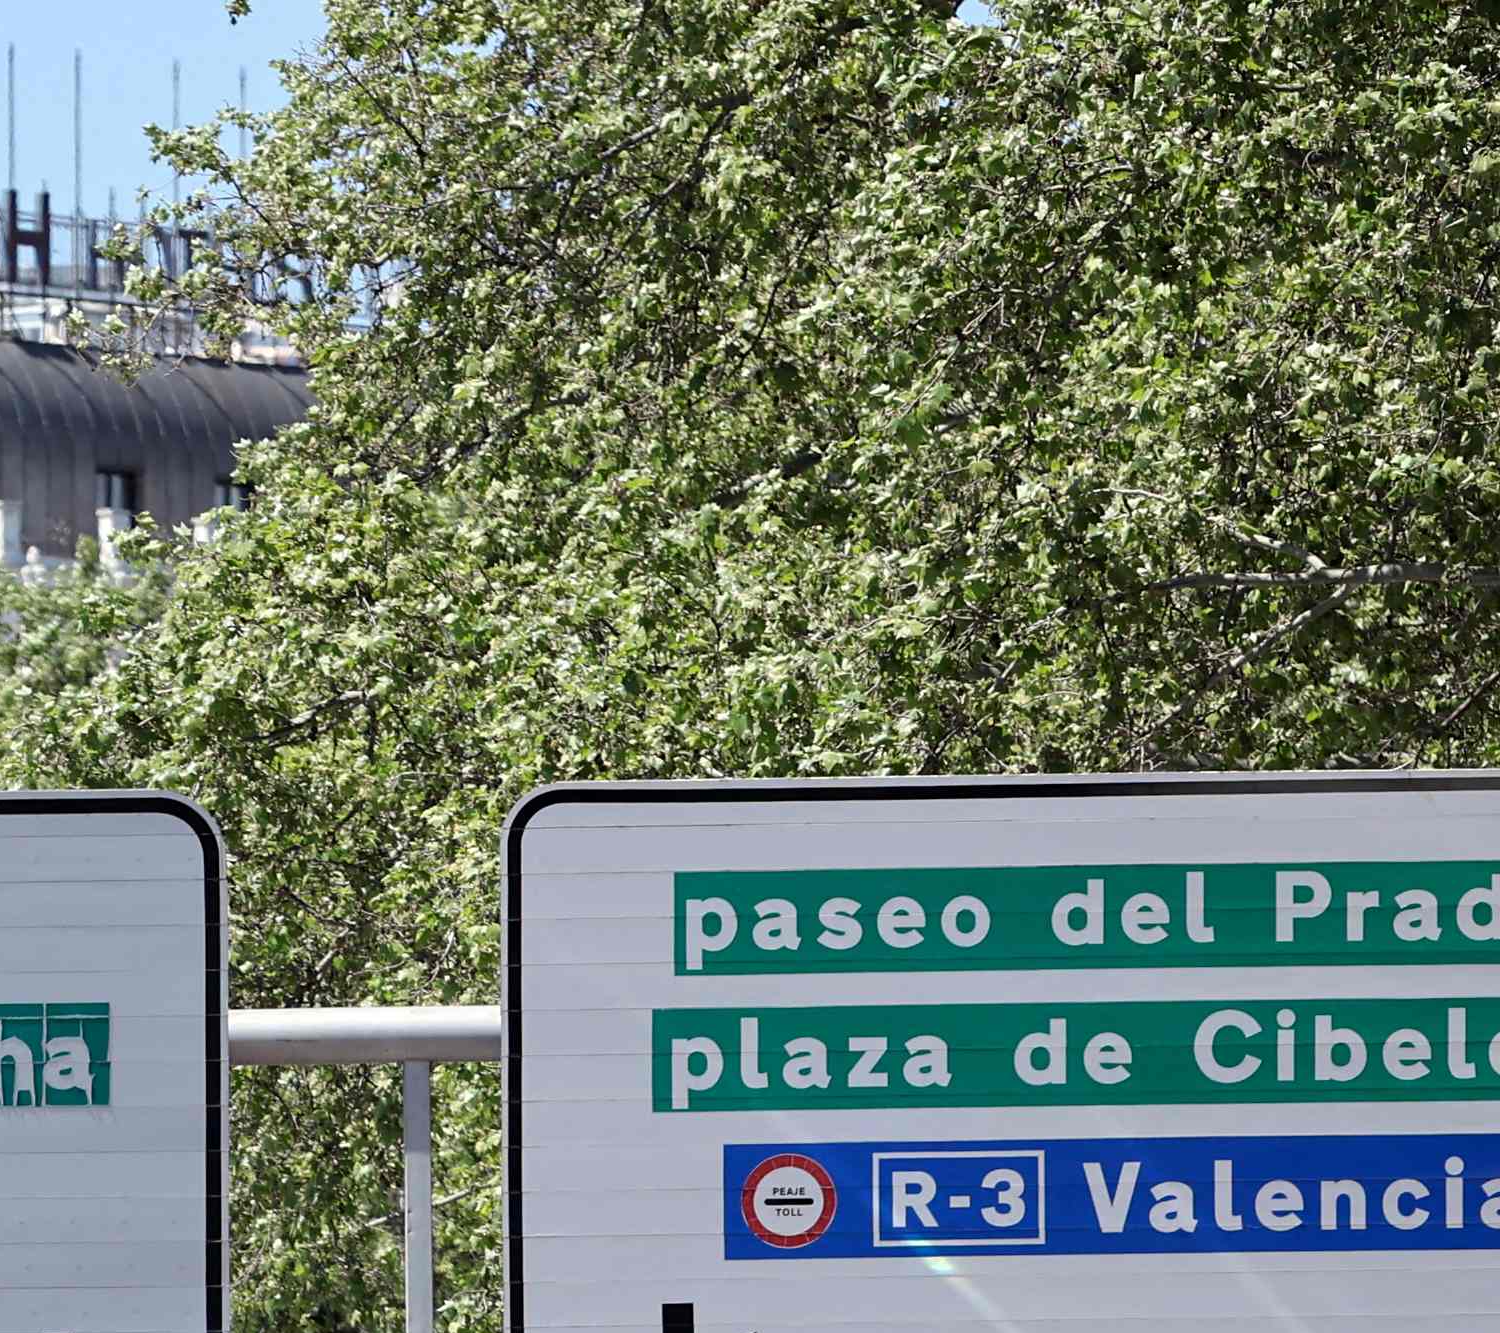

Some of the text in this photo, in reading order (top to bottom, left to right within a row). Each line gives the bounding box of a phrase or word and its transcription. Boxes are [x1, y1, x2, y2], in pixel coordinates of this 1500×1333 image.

[685, 893, 992, 971] paseo
[1052, 870, 1216, 946] del
[670, 1006, 1500, 1111] plaza de Cibel
[772, 1187, 806, 1196] PEAJE
[775, 1208, 804, 1217] TOLL
[890, 1168, 1028, 1230] R-3
